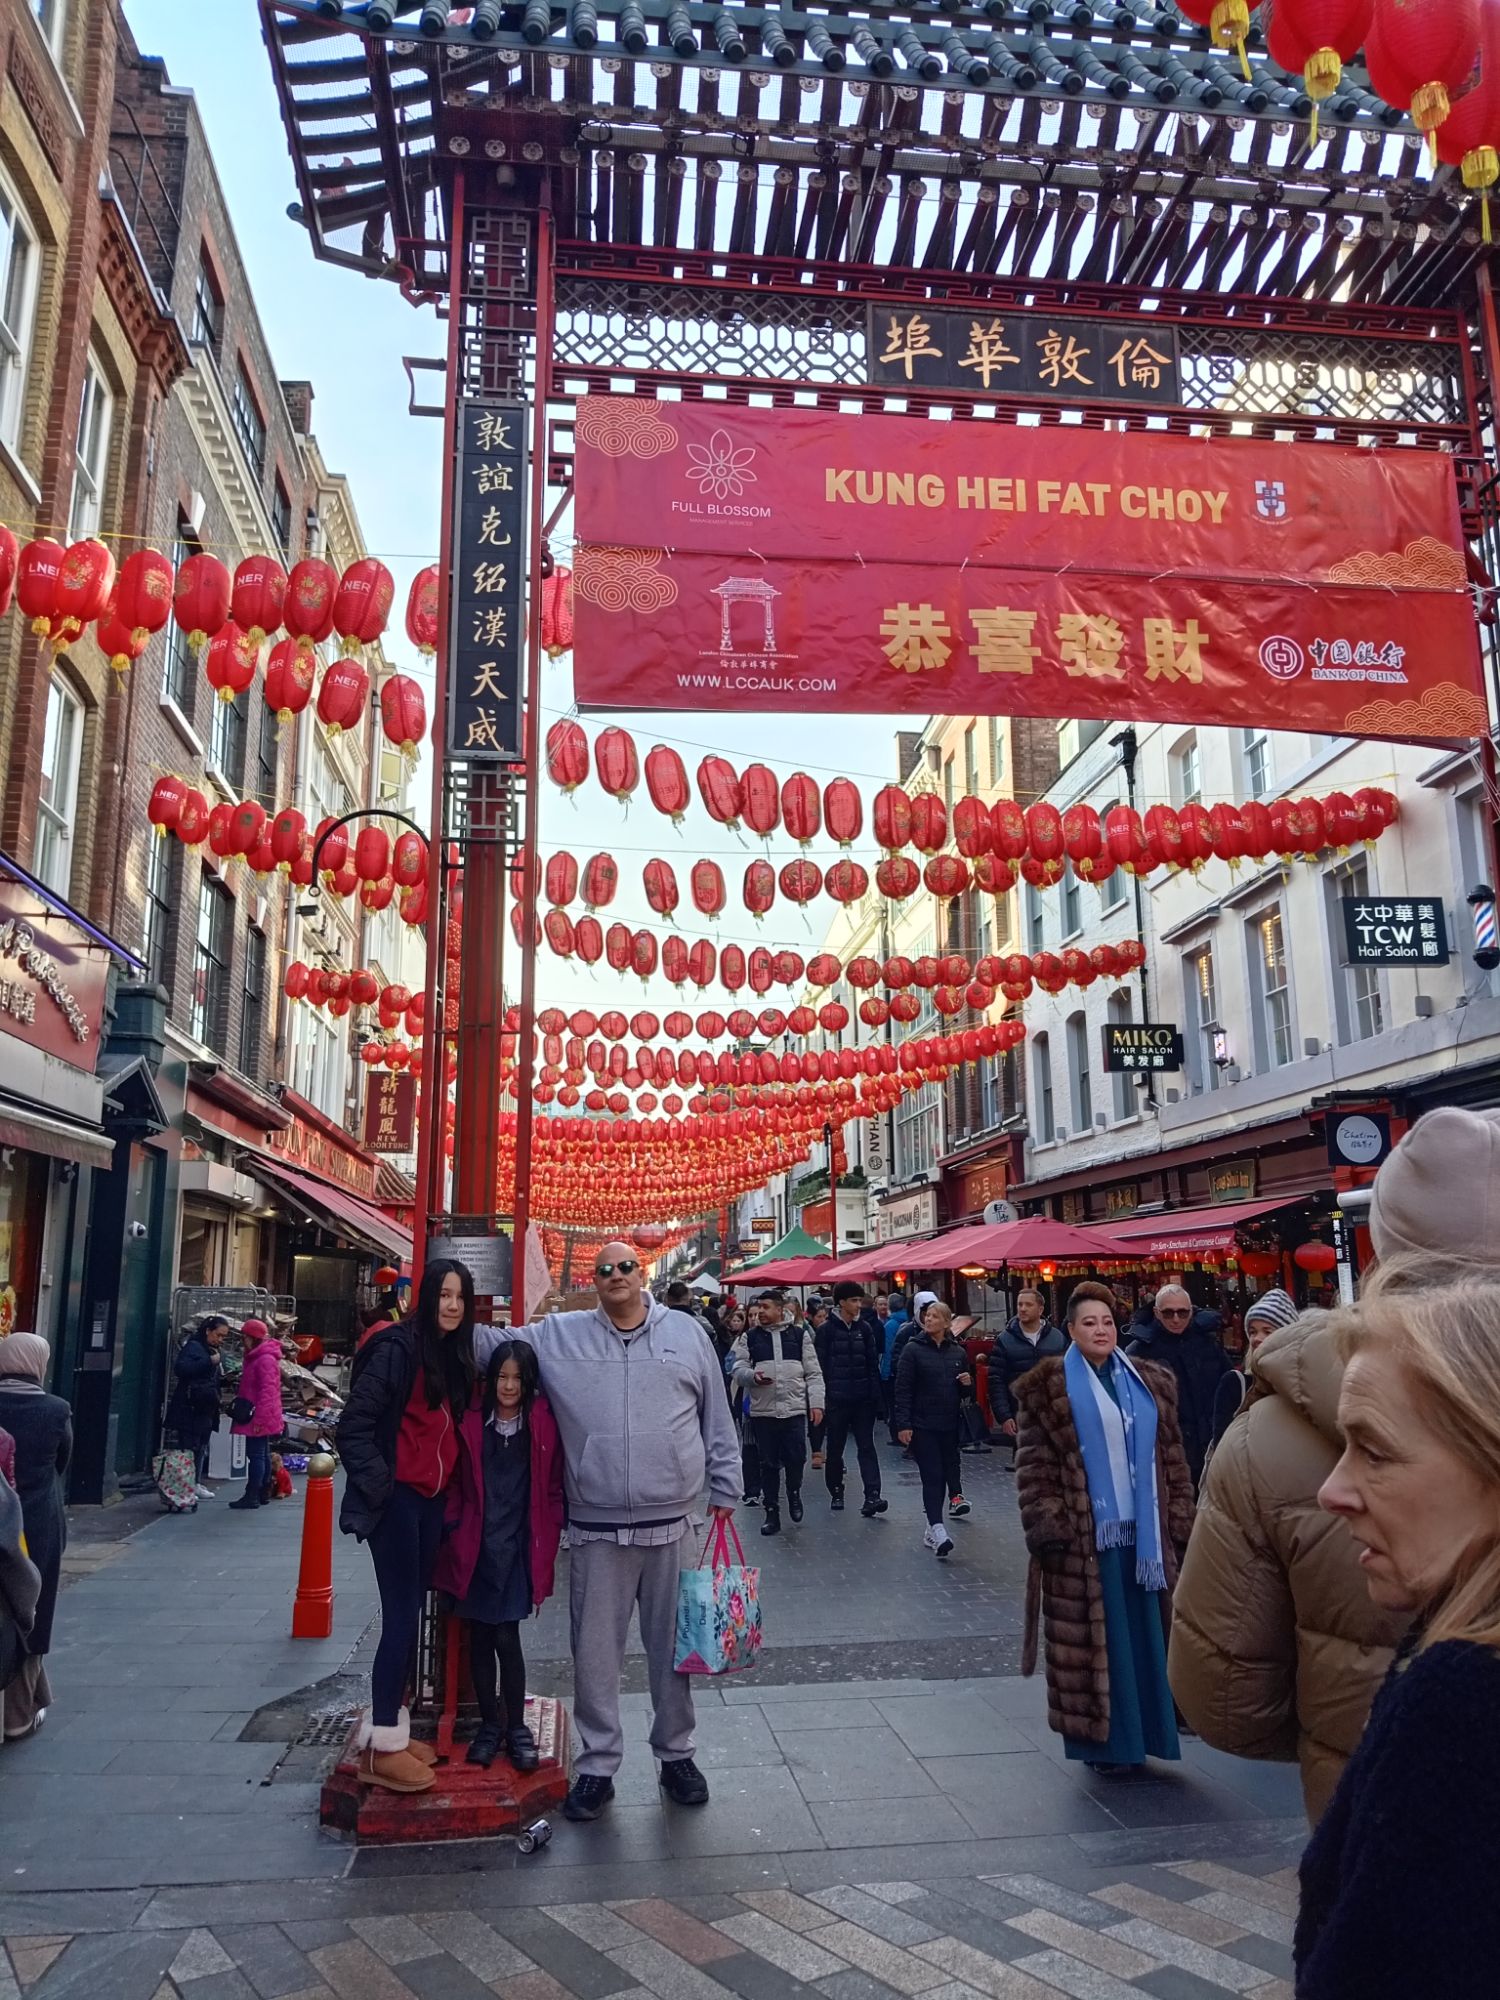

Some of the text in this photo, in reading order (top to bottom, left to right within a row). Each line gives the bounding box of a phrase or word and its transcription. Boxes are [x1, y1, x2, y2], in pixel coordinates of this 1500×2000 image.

[826, 468, 945, 507] KUNG
[958, 476, 1027, 512] HEI
[1037, 480, 1110, 516] FAT
[1120, 485, 1229, 523] CHOY
[672, 501, 771, 517] FULL BLOSSOM
[237, 574, 263, 586] NER
[880, 603, 1209, 684] 恭喜發財
[328, 675, 359, 689] LNER
[677, 674, 837, 691] WWW.LCCAUK.COM
[1312, 668, 1408, 683] BANK OF CHINA
[1354, 904, 1414, 923] 大中華
[1356, 925, 1414, 944] TCW
[1418, 904, 1439, 957] 美髮廊
[1358, 945, 1418, 957] Hair Salon
[1113, 1029, 1172, 1046] MIKO
[682, 1589, 690, 1639] Poundland
